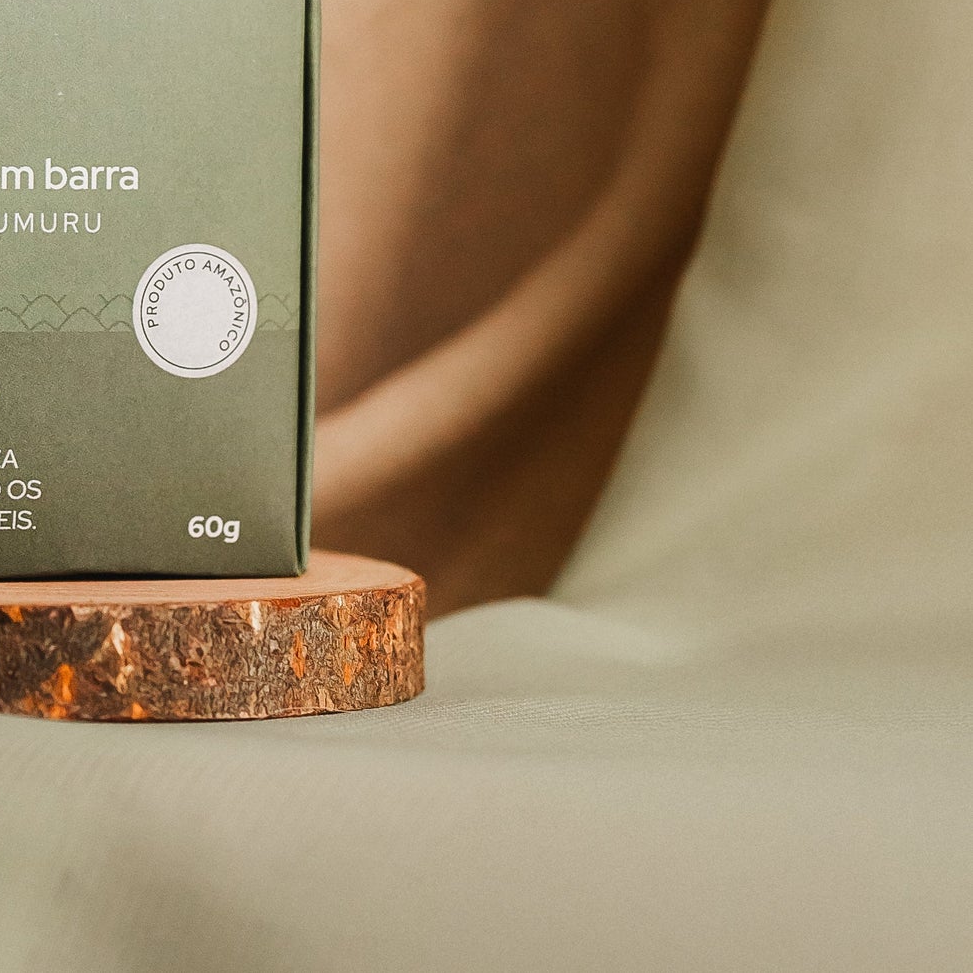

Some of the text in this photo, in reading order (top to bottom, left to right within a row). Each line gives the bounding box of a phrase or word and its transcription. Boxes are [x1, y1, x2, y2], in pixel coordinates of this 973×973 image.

[44, 158, 139, 190] barra
[147, 259, 247, 351] PRODUTO AMAZÔNICO
[7, 479, 42, 500] OS
[188, 515, 240, 543] 60g
